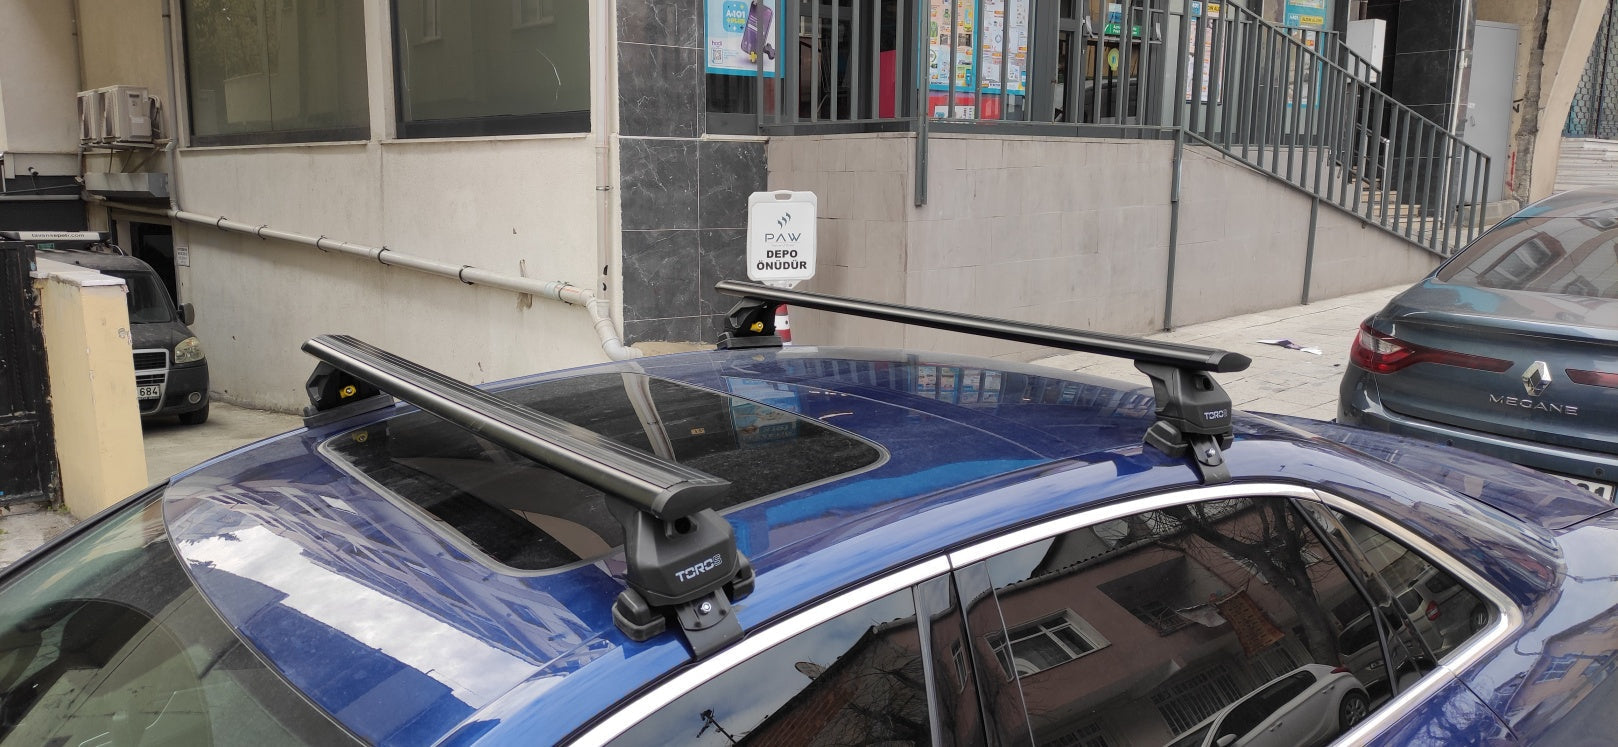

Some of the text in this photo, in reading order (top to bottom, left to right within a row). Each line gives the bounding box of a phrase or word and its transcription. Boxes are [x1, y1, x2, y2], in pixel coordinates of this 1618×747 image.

[765, 233, 801, 242] PAW
[766, 249, 798, 258] DEPO
[756, 259, 807, 271] ÖNÜDÜR
[139, 386, 158, 397] 684
[1489, 394, 1579, 416] MEGANE
[675, 553, 723, 582] TOROS
